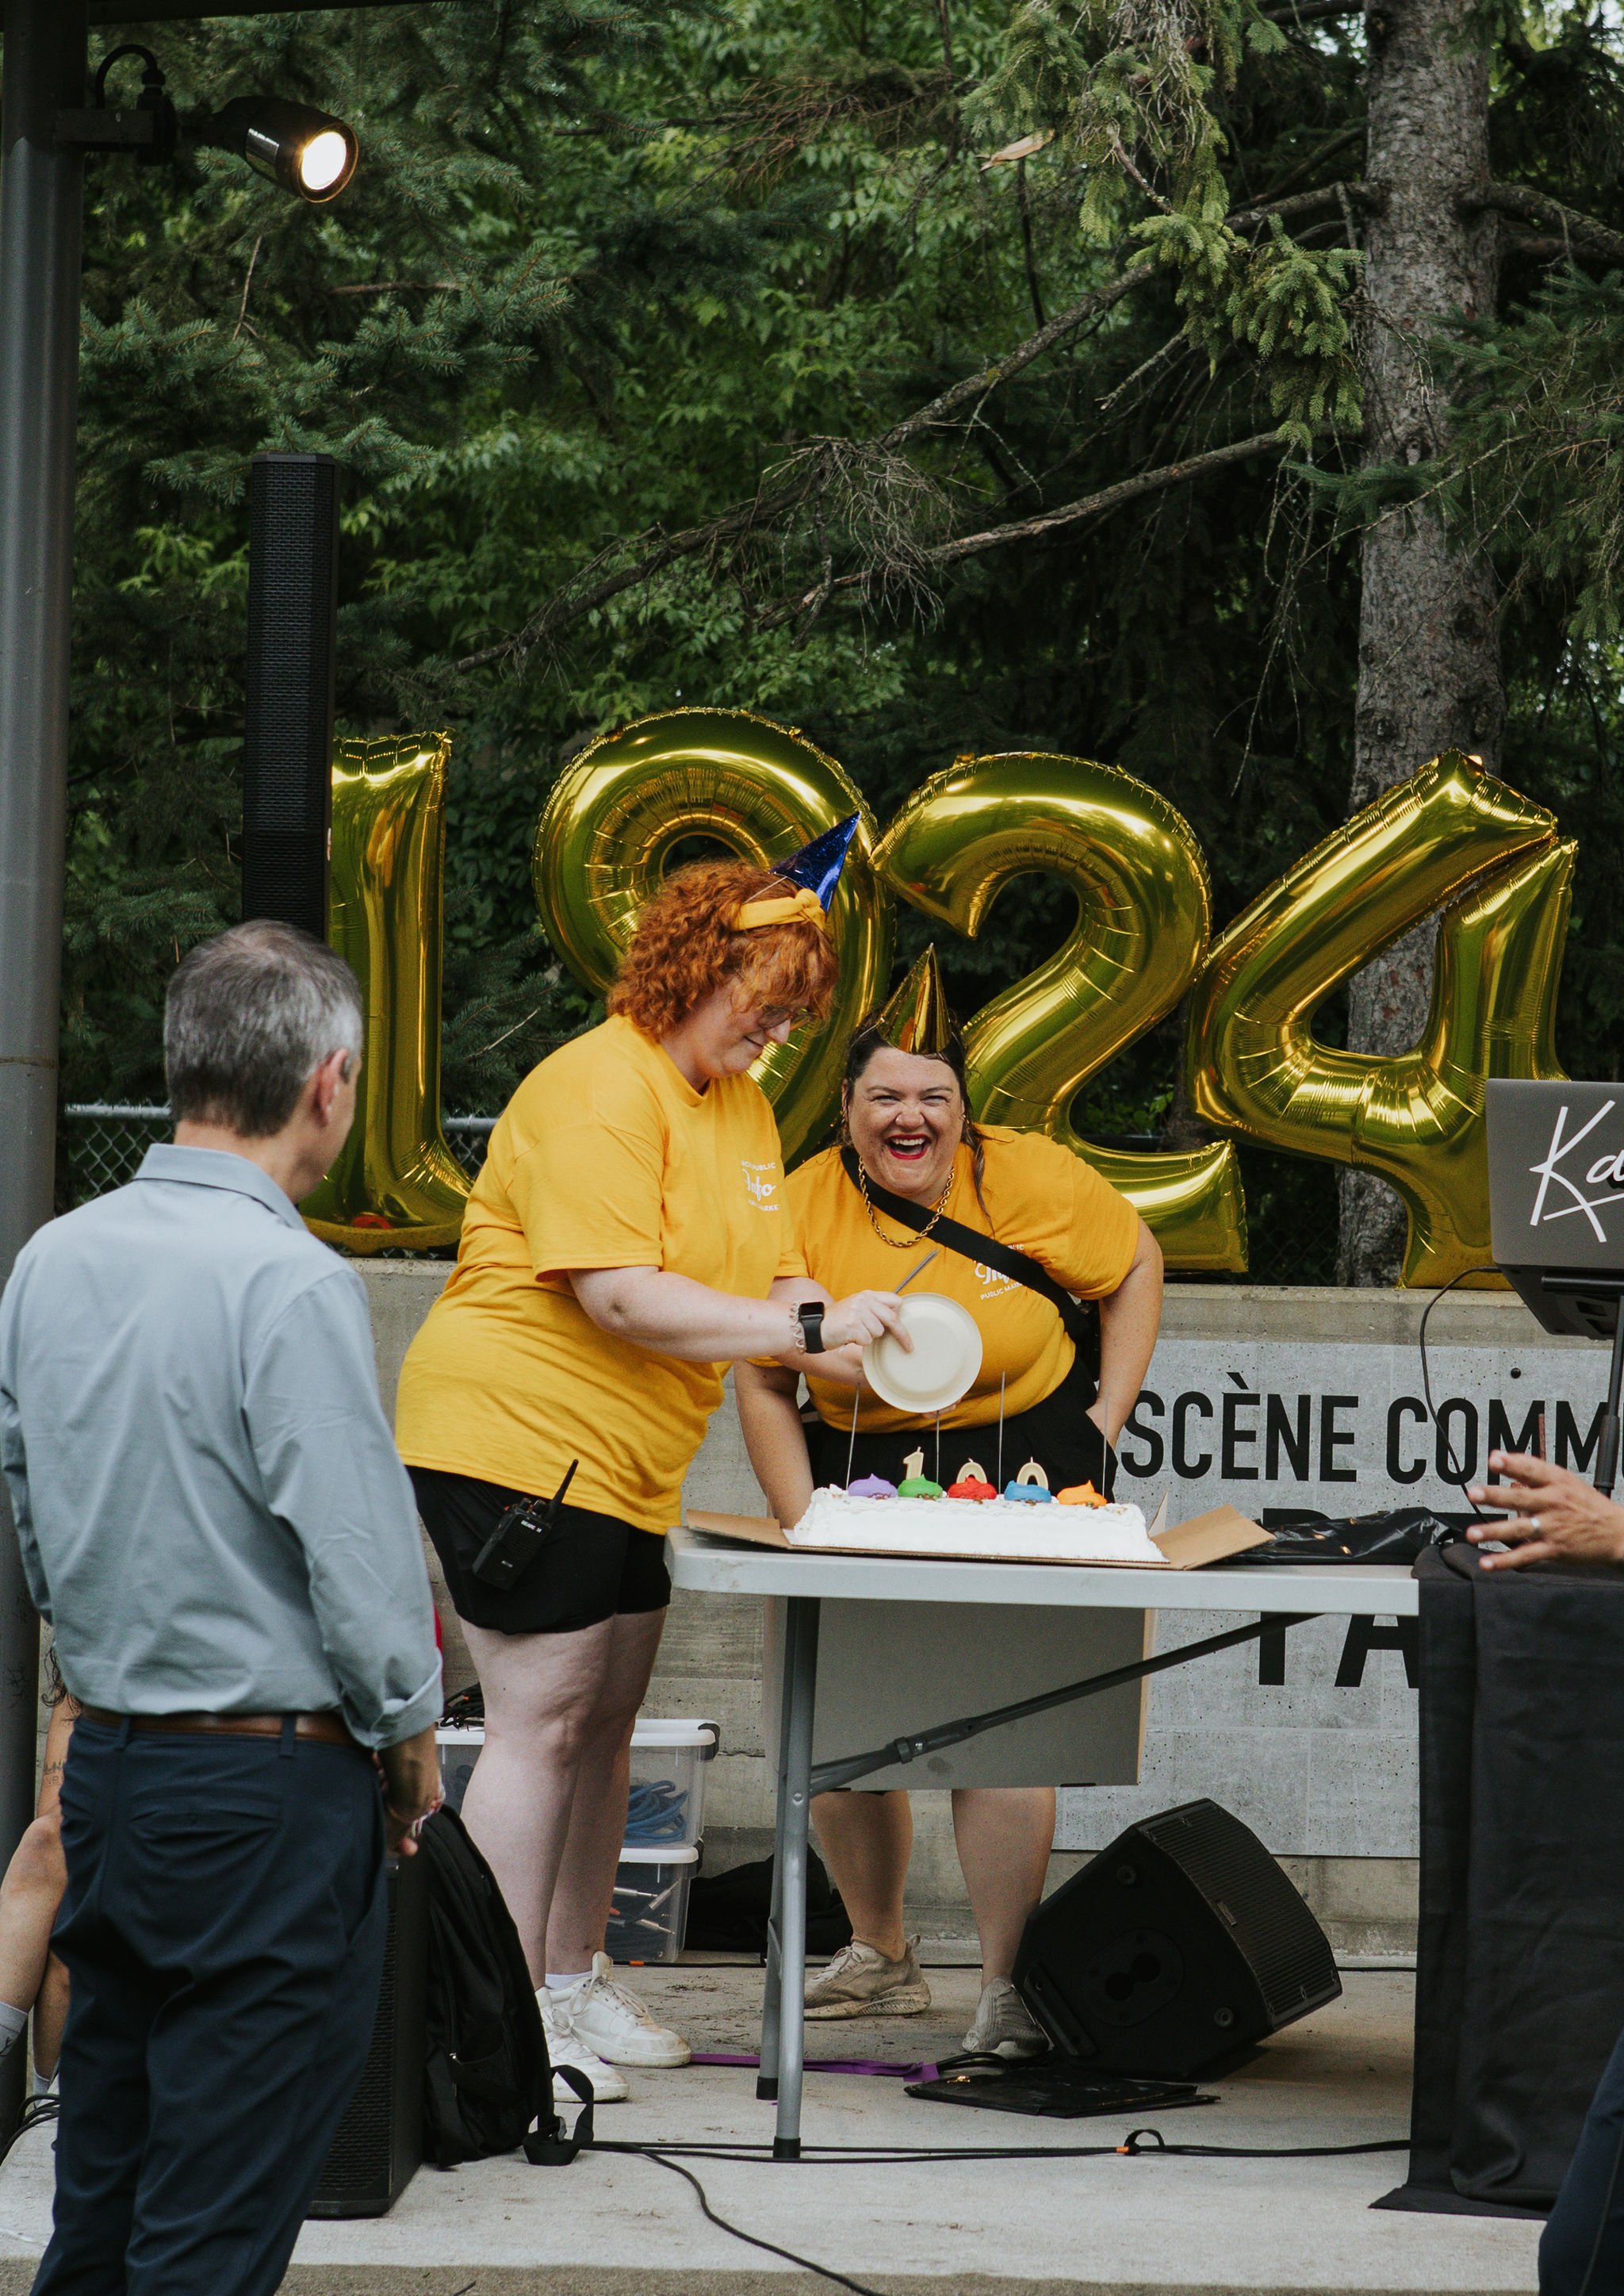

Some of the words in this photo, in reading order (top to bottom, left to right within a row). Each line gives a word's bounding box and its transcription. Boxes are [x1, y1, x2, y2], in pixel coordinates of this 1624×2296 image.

[980, 1288, 1004, 1300] PUBLIC
[1120, 1372, 1359, 1483] SCÈNE
[1386, 1397, 1624, 1485] COMM
